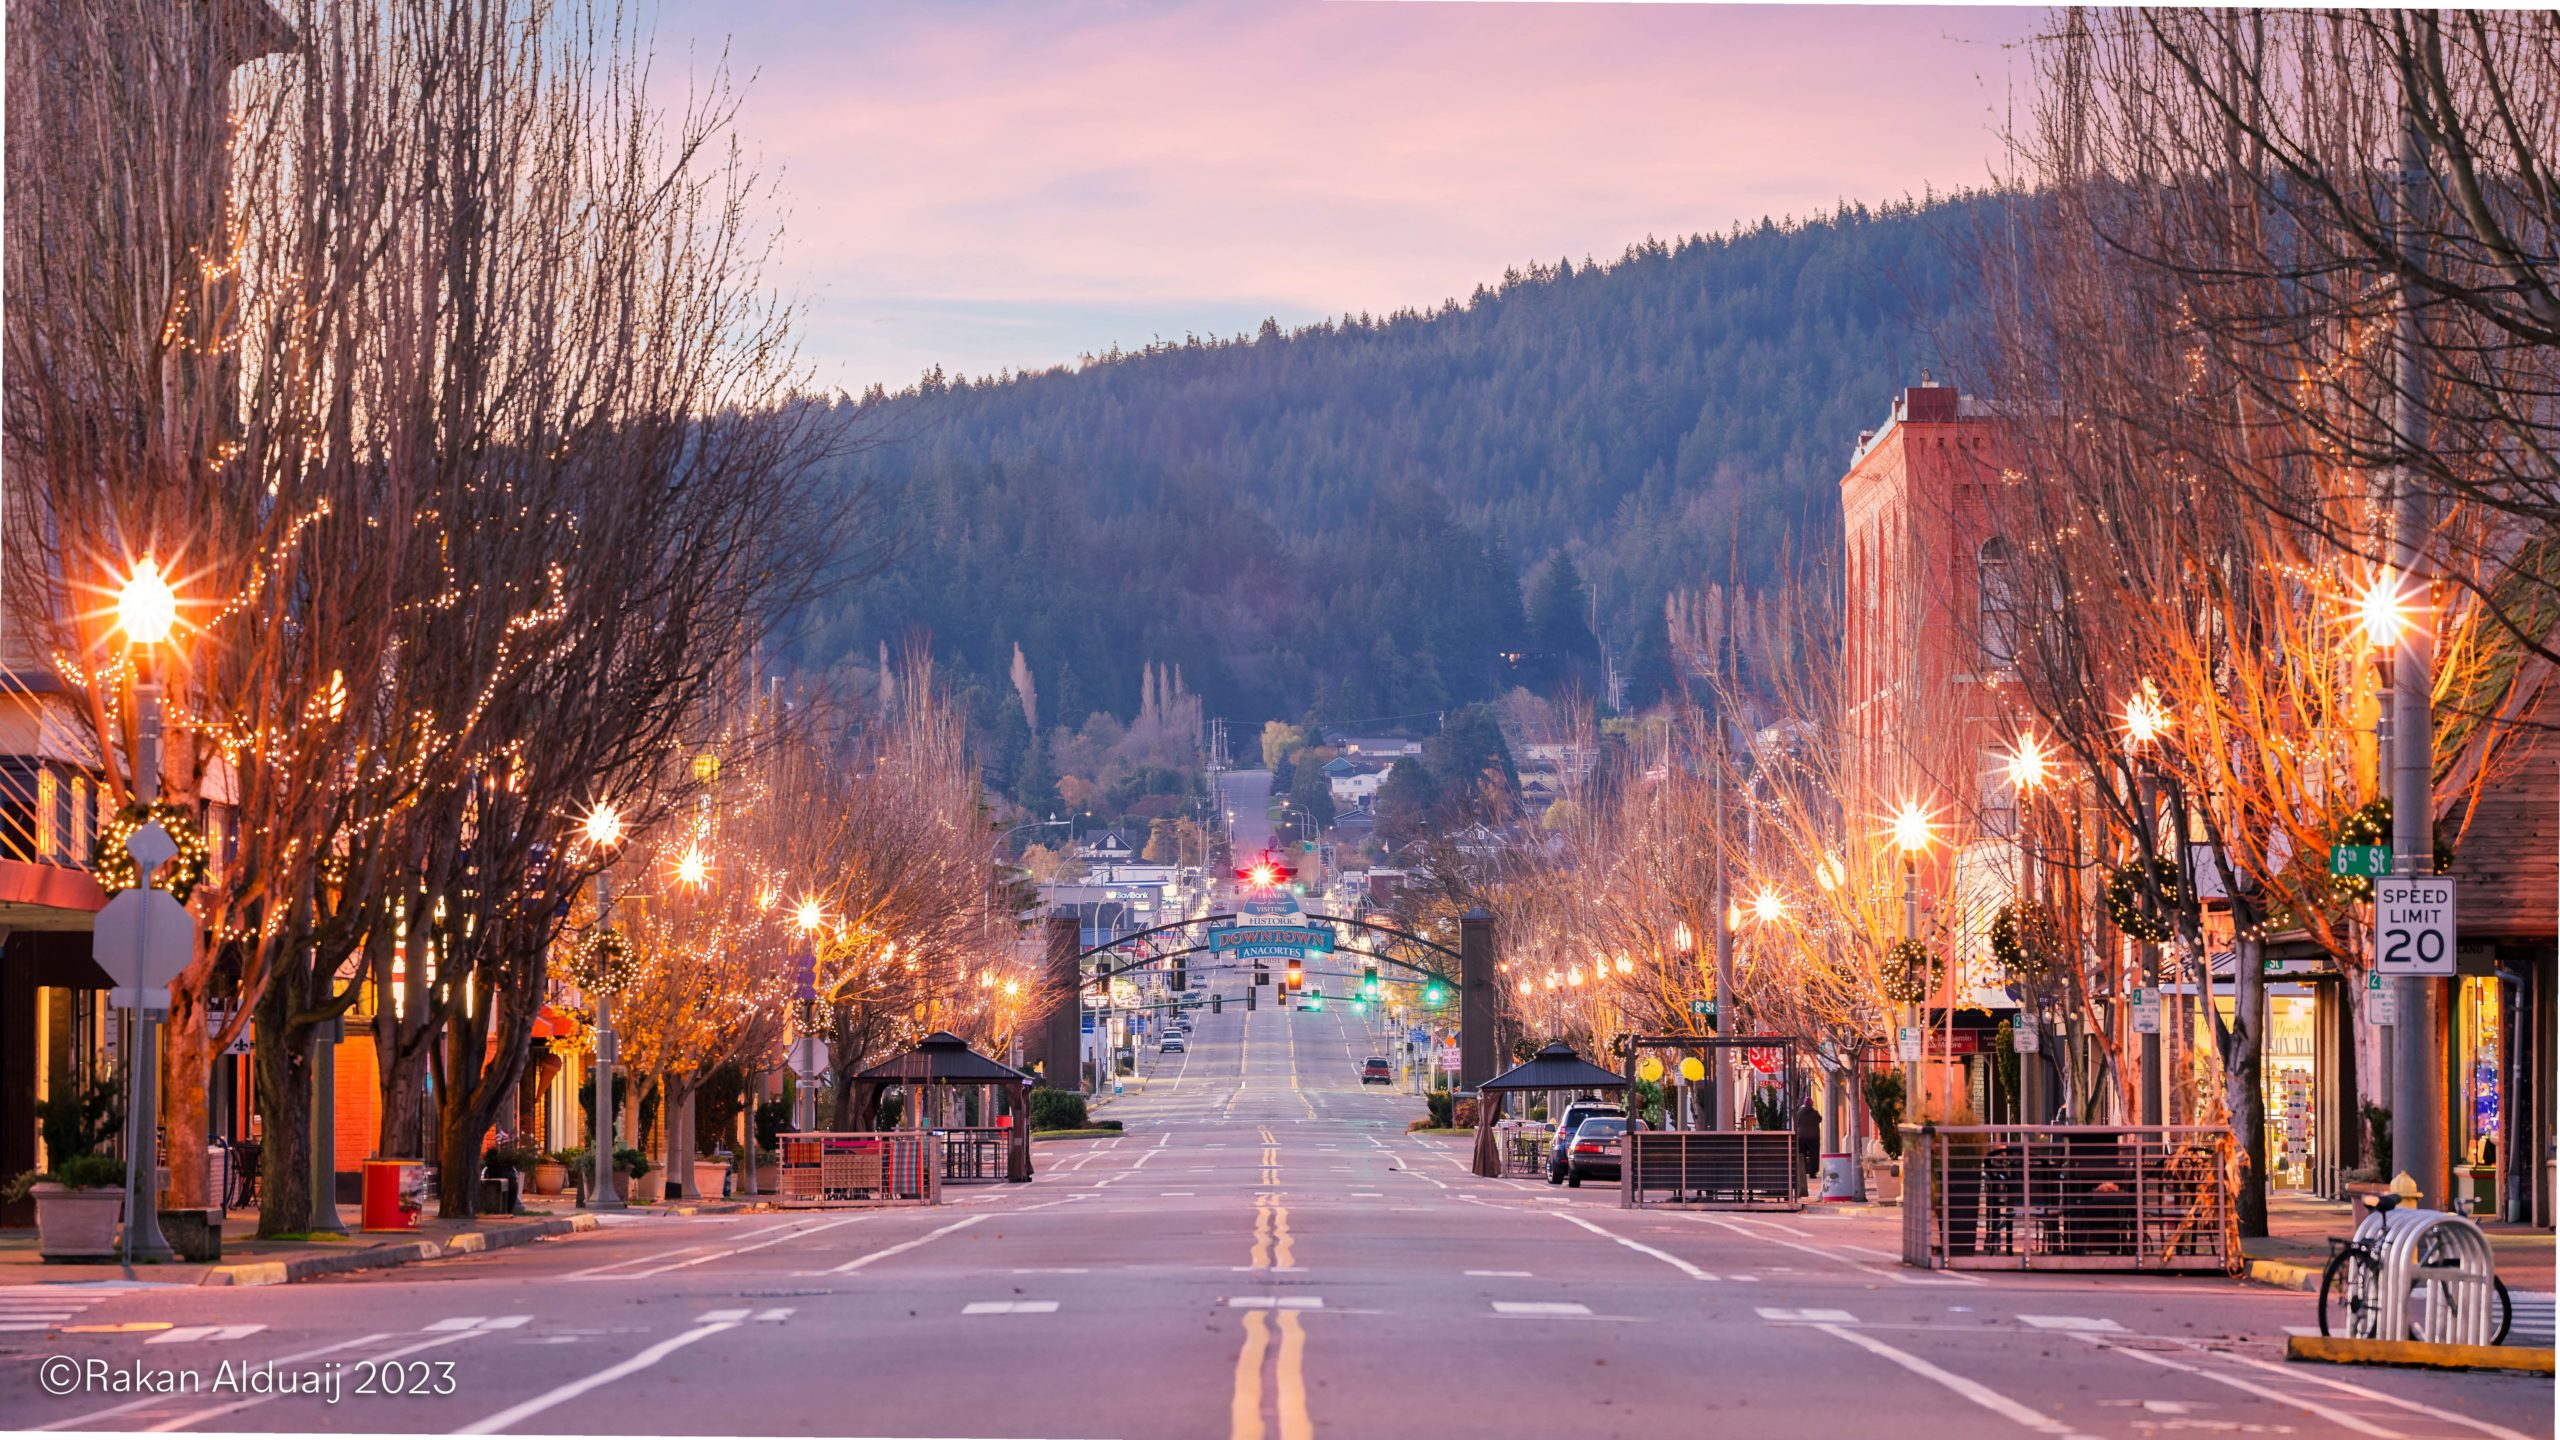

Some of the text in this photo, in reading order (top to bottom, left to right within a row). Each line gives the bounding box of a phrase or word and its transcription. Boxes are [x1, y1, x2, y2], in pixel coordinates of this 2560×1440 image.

[2337, 848, 2385, 873] 6th St
[2383, 889, 2448, 904] SPEED
[1249, 917, 1297, 925] HISTORIC
[2390, 909, 2441, 924] LIMIT
[1218, 929, 1326, 948] DOWNTOWN
[1243, 946, 1301, 957] ANACORTES
[2384, 928, 2445, 964] 20
[2134, 990, 2140, 1004] 2
[1706, 1001, 1715, 1012] St
[2015, 1016, 2021, 1027] 2
[1901, 1029, 1906, 1039] 2
[1937, 1034, 1972, 1043] Bejamin
